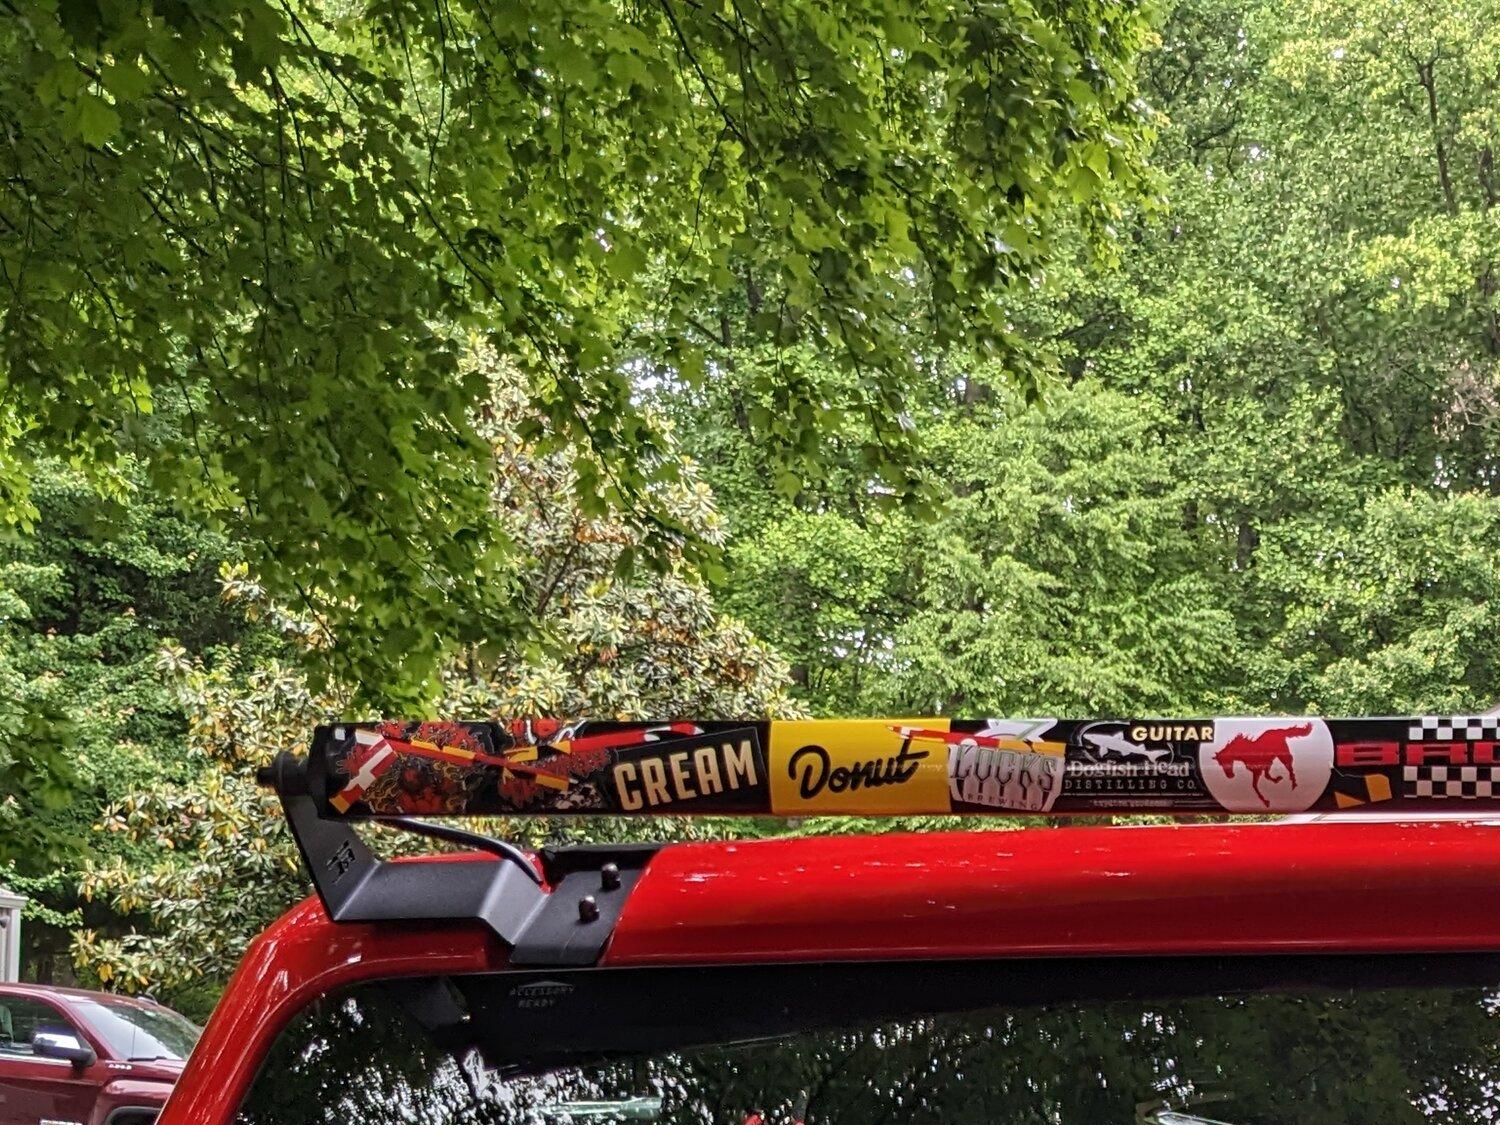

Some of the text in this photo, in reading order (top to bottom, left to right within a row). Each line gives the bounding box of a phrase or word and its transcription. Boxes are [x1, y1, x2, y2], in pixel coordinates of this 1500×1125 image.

[1131, 725, 1214, 742] GUITAR
[613, 739, 758, 811] CREAM
[787, 736, 930, 800] Donut
[1068, 759, 1190, 777] Dogfish Head
[1064, 779, 1168, 790] DISTILLING
[967, 792, 1038, 811] BREWING
